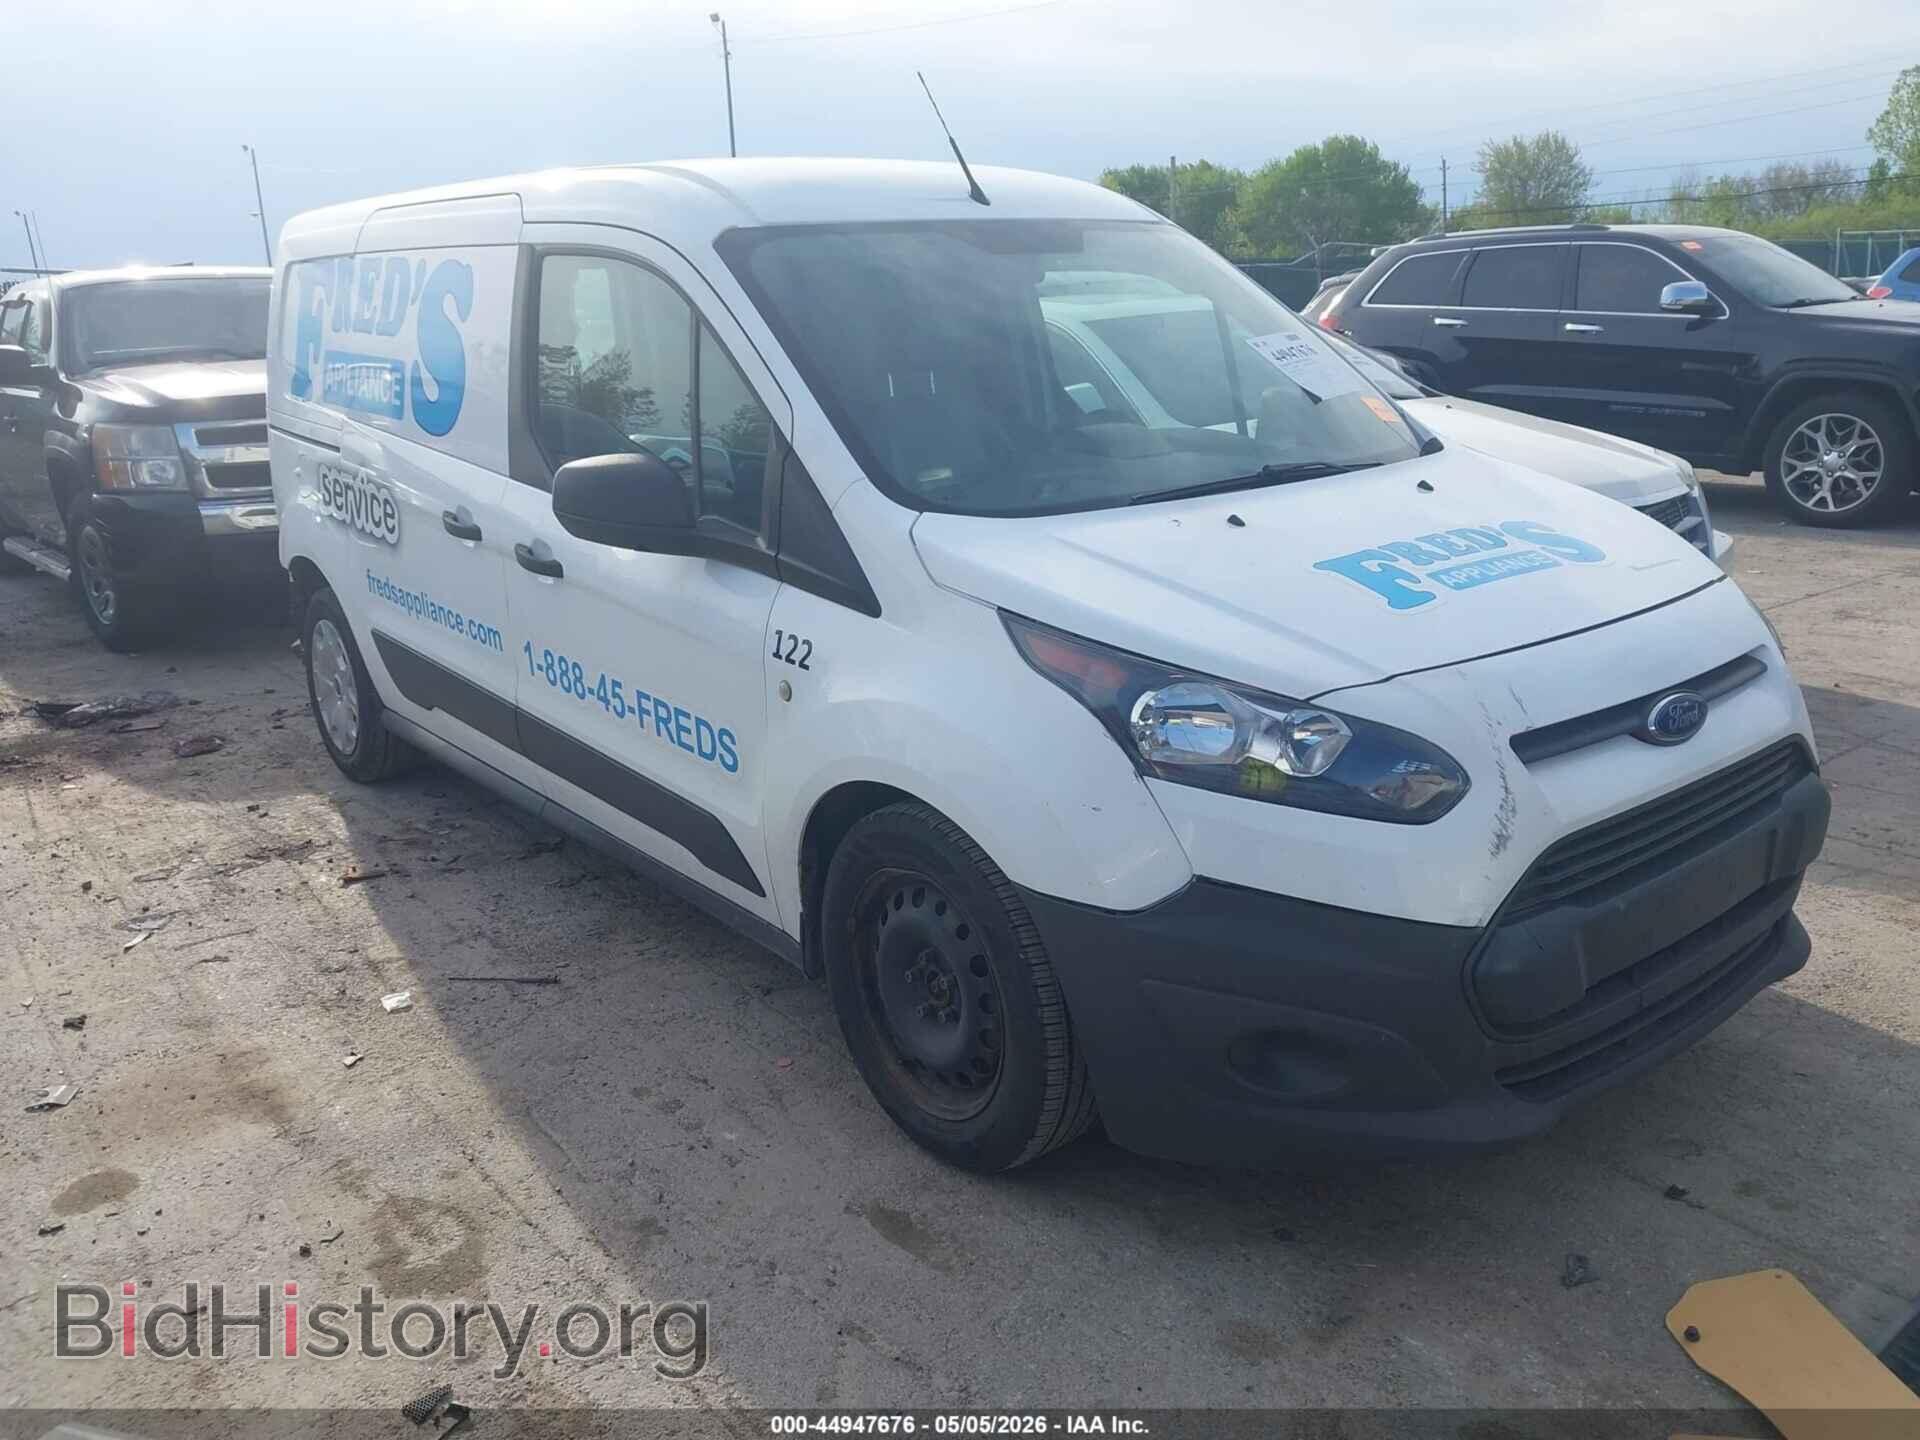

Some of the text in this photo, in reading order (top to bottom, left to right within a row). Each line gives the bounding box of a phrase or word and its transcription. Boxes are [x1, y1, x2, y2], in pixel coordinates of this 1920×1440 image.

[289, 257, 474, 437] FRED'S
[321, 473, 396, 534] service
[1312, 520, 1606, 610] FRED'S
[1438, 551, 1557, 586] APPLIANCE
[366, 568, 504, 652] fredsappliance.com
[771, 629, 814, 672] 122
[523, 640, 740, 774] 1-888-45-FREDS
